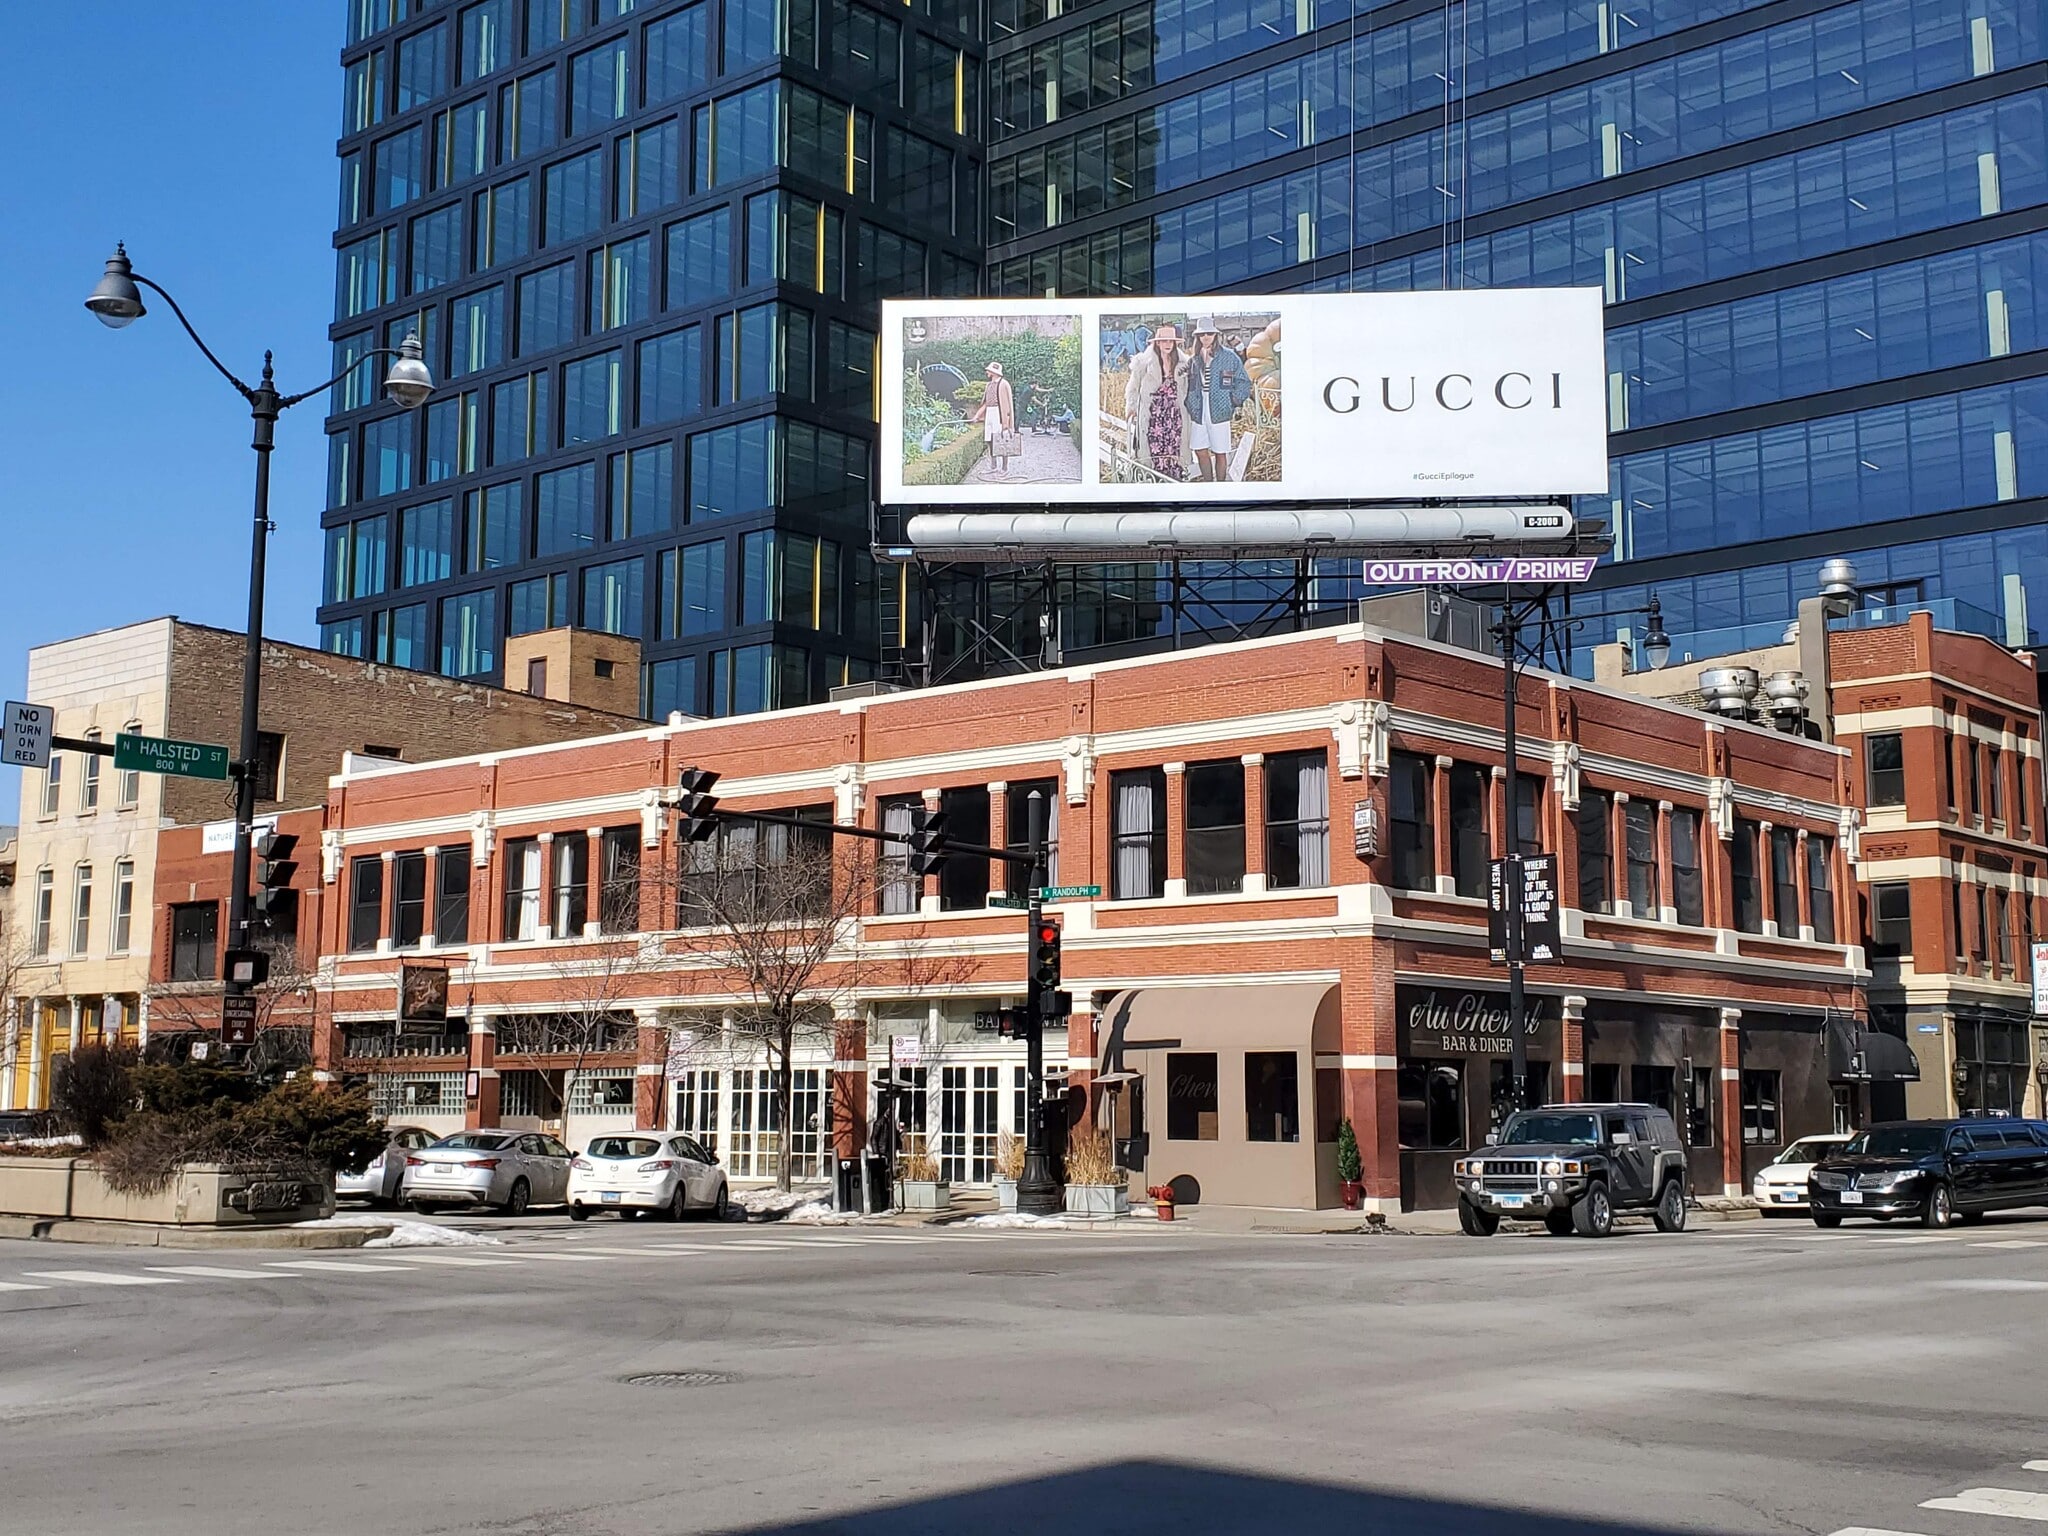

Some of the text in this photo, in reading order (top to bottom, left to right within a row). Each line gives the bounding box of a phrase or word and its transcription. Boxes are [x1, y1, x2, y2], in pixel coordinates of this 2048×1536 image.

[1322, 372, 1561, 414] GUCCI
[1413, 472, 1475, 481] #GucciEpilogue
[19, 708, 39, 722] NO
[14, 723, 41, 736] TURN
[19, 737, 34, 749] ON
[15, 750, 36, 761] RED
[123, 741, 222, 762] N HALSTED ST
[155, 759, 190, 772] 800 W
[1524, 859, 1548, 870] WHERE
[1491, 863, 1501, 911] WEST LOOP
[1525, 880, 1549, 891] OF THE
[1052, 887, 1089, 897] RANDOLPH
[1546, 891, 1554, 900] IS
[1525, 901, 1551, 912] A GOOD
[1409, 991, 1450, 1030] Au
[1442, 1036, 1514, 1053] BAR & DINER
